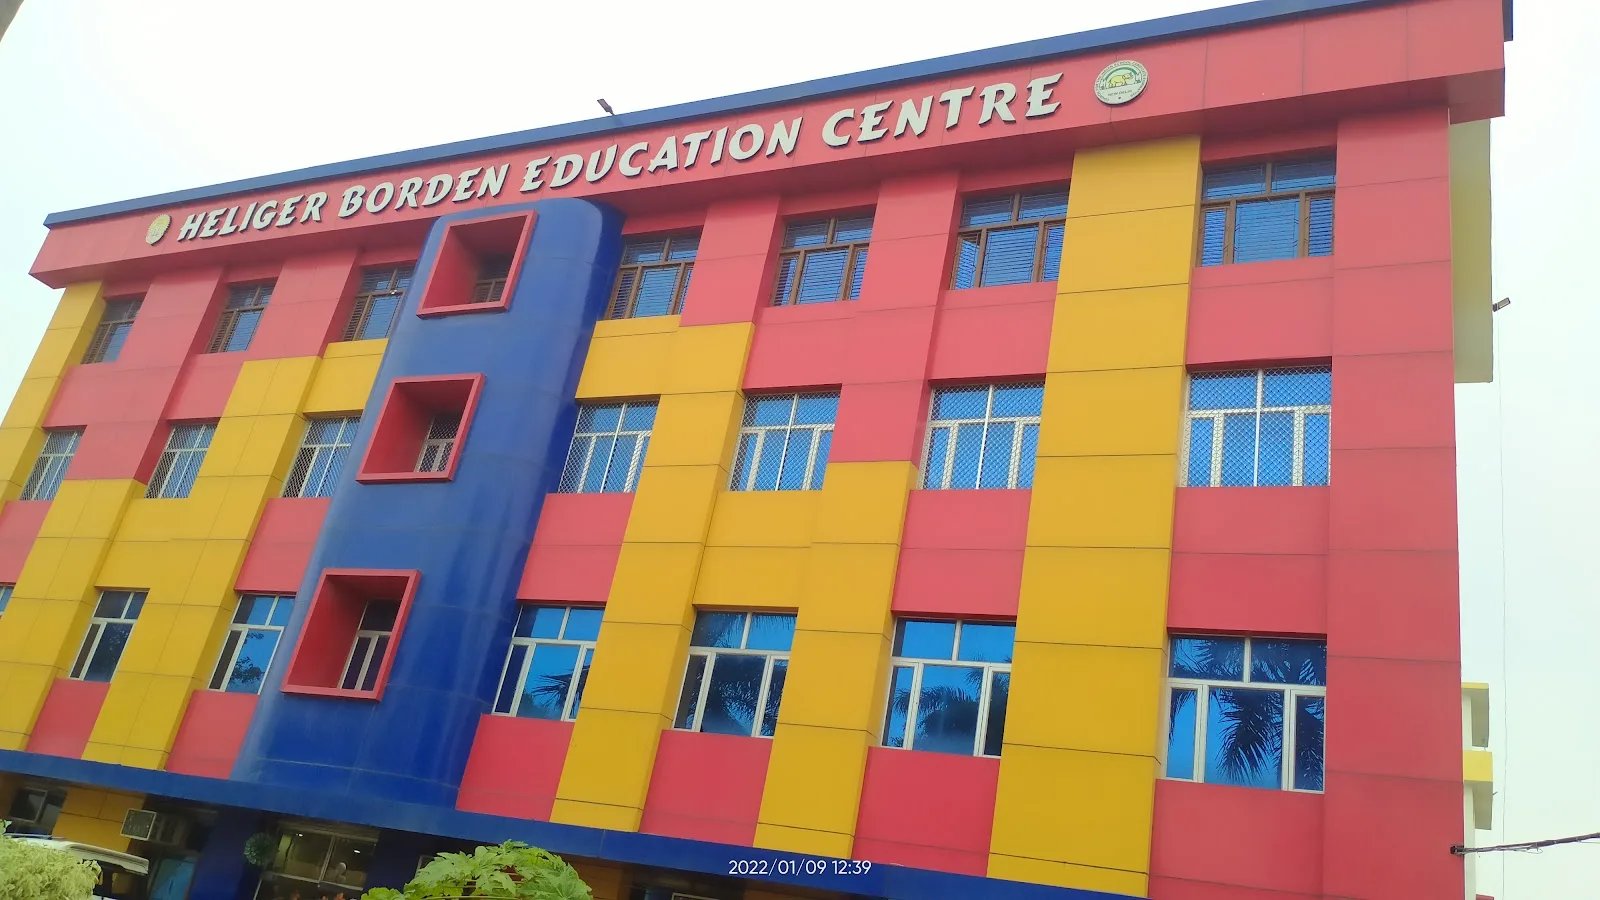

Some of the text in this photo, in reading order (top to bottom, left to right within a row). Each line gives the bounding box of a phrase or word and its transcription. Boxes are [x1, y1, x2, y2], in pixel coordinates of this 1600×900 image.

[177, 191, 328, 241] HELIGER
[337, 163, 511, 218] BORDEN
[519, 117, 803, 192] EDUCATION
[821, 72, 1064, 147] CENTRE
